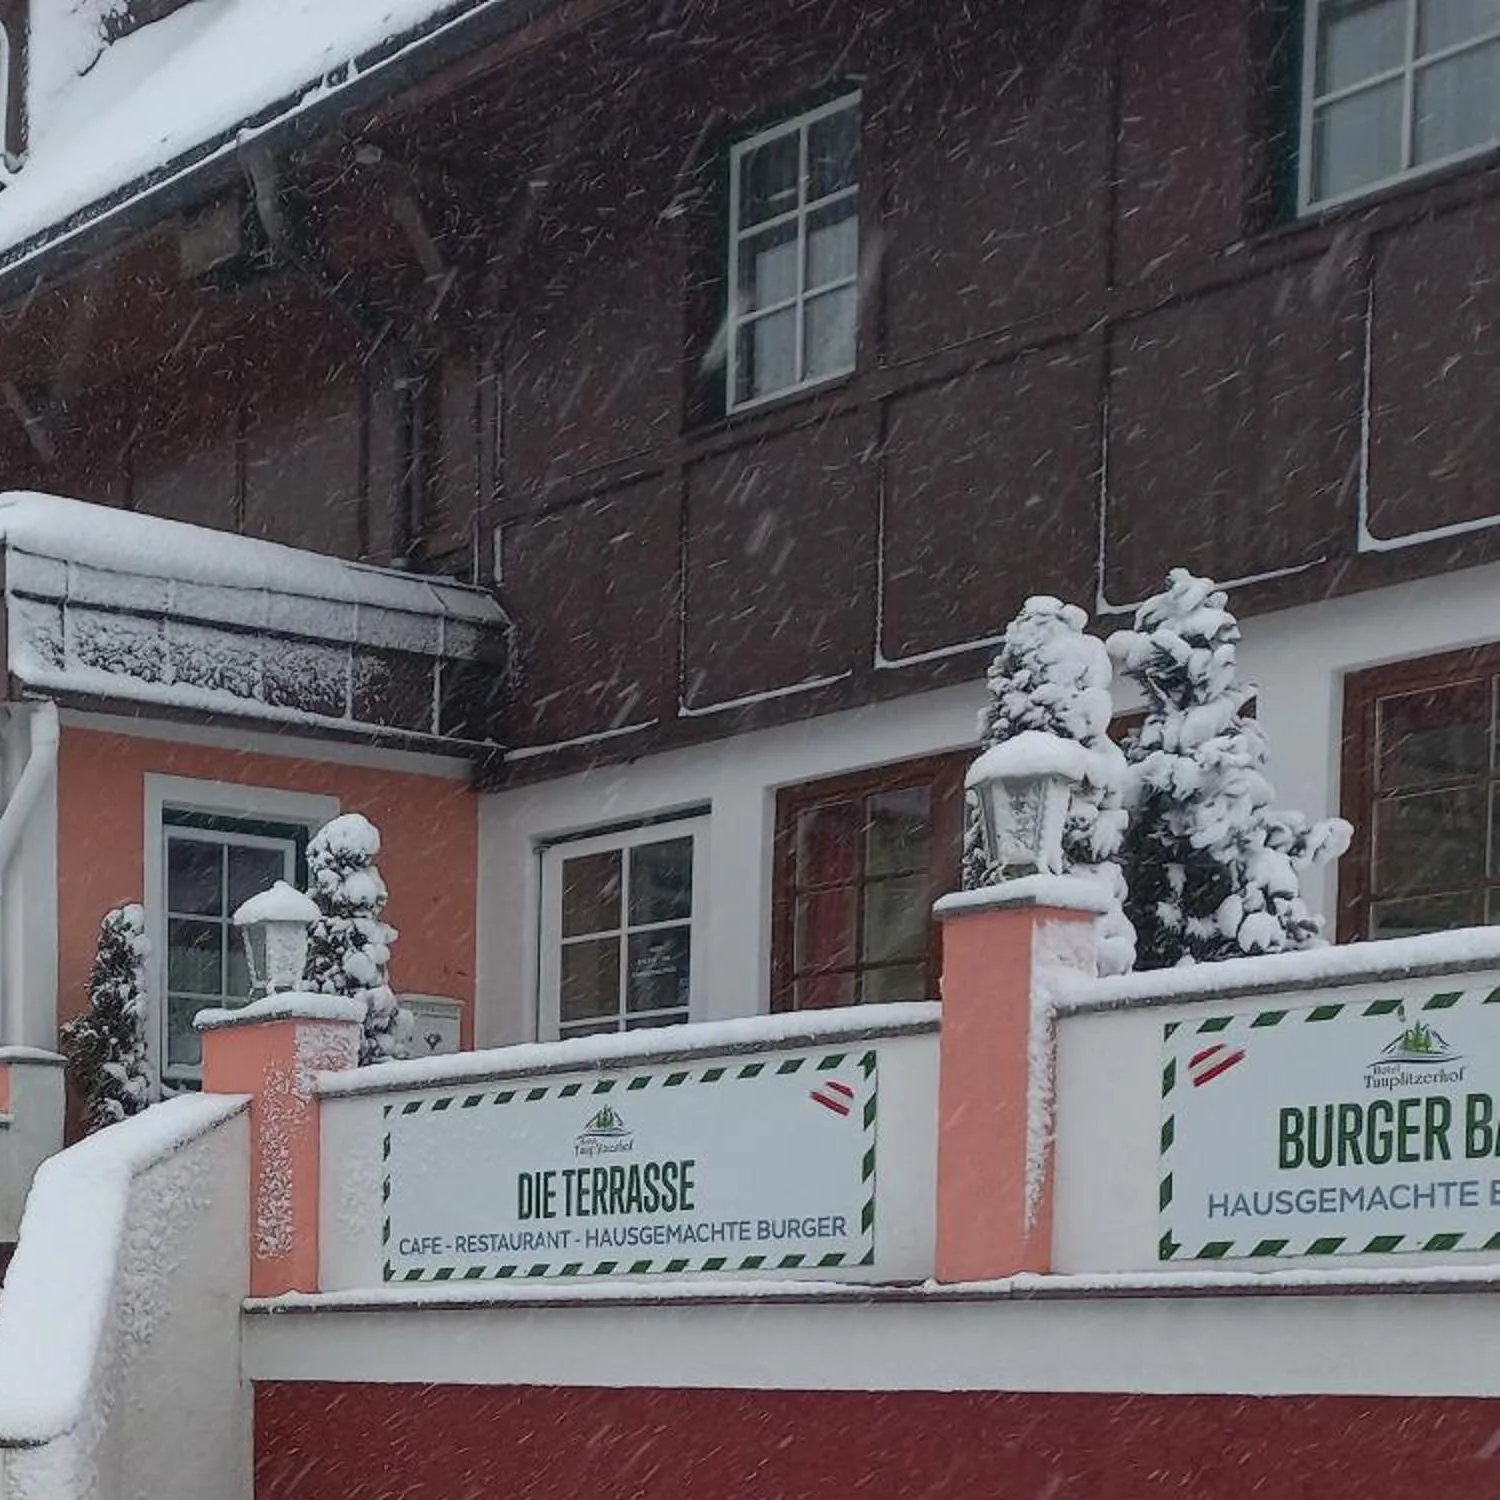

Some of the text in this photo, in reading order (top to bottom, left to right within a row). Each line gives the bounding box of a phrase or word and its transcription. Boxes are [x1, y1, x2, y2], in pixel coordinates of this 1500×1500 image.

[1278, 1093, 1500, 1170] BURGER B
[518, 1159, 696, 1220] DIE TERRASSE
[1208, 1180, 1479, 1218] HAUSGEMACHTE
[399, 1236, 443, 1256] CAFE
[455, 1229, 571, 1254] RESTAURANT
[585, 1220, 752, 1249] HAUSGEMACHTE
[757, 1215, 847, 1241] BURGER
